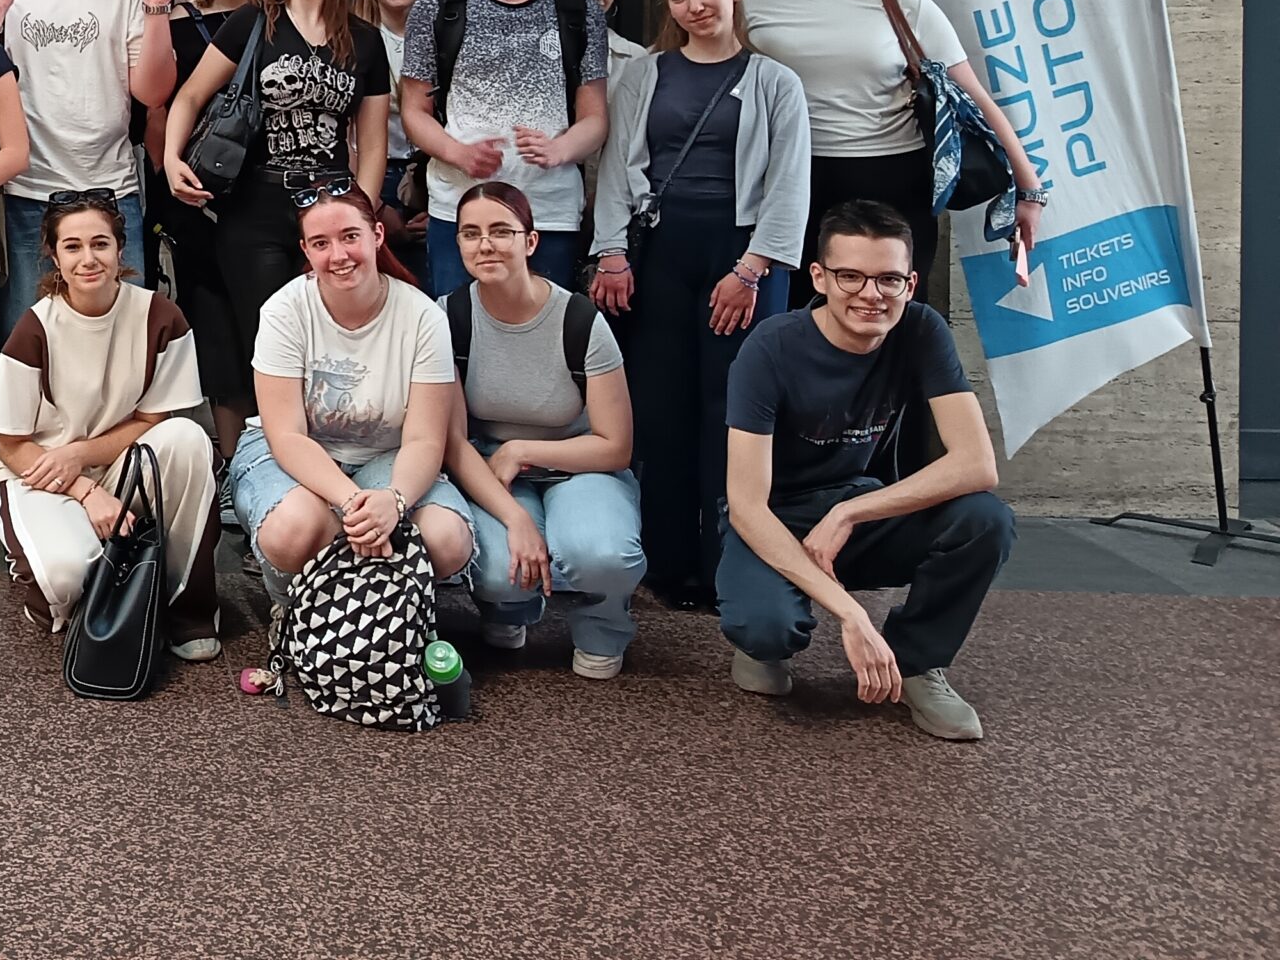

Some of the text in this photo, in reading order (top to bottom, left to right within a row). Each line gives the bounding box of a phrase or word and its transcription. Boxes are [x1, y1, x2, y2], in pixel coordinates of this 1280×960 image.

[1058, 232, 1135, 269] TICKETS
[1061, 265, 1108, 290] INFO
[1066, 267, 1172, 315] SOUVENIRS
